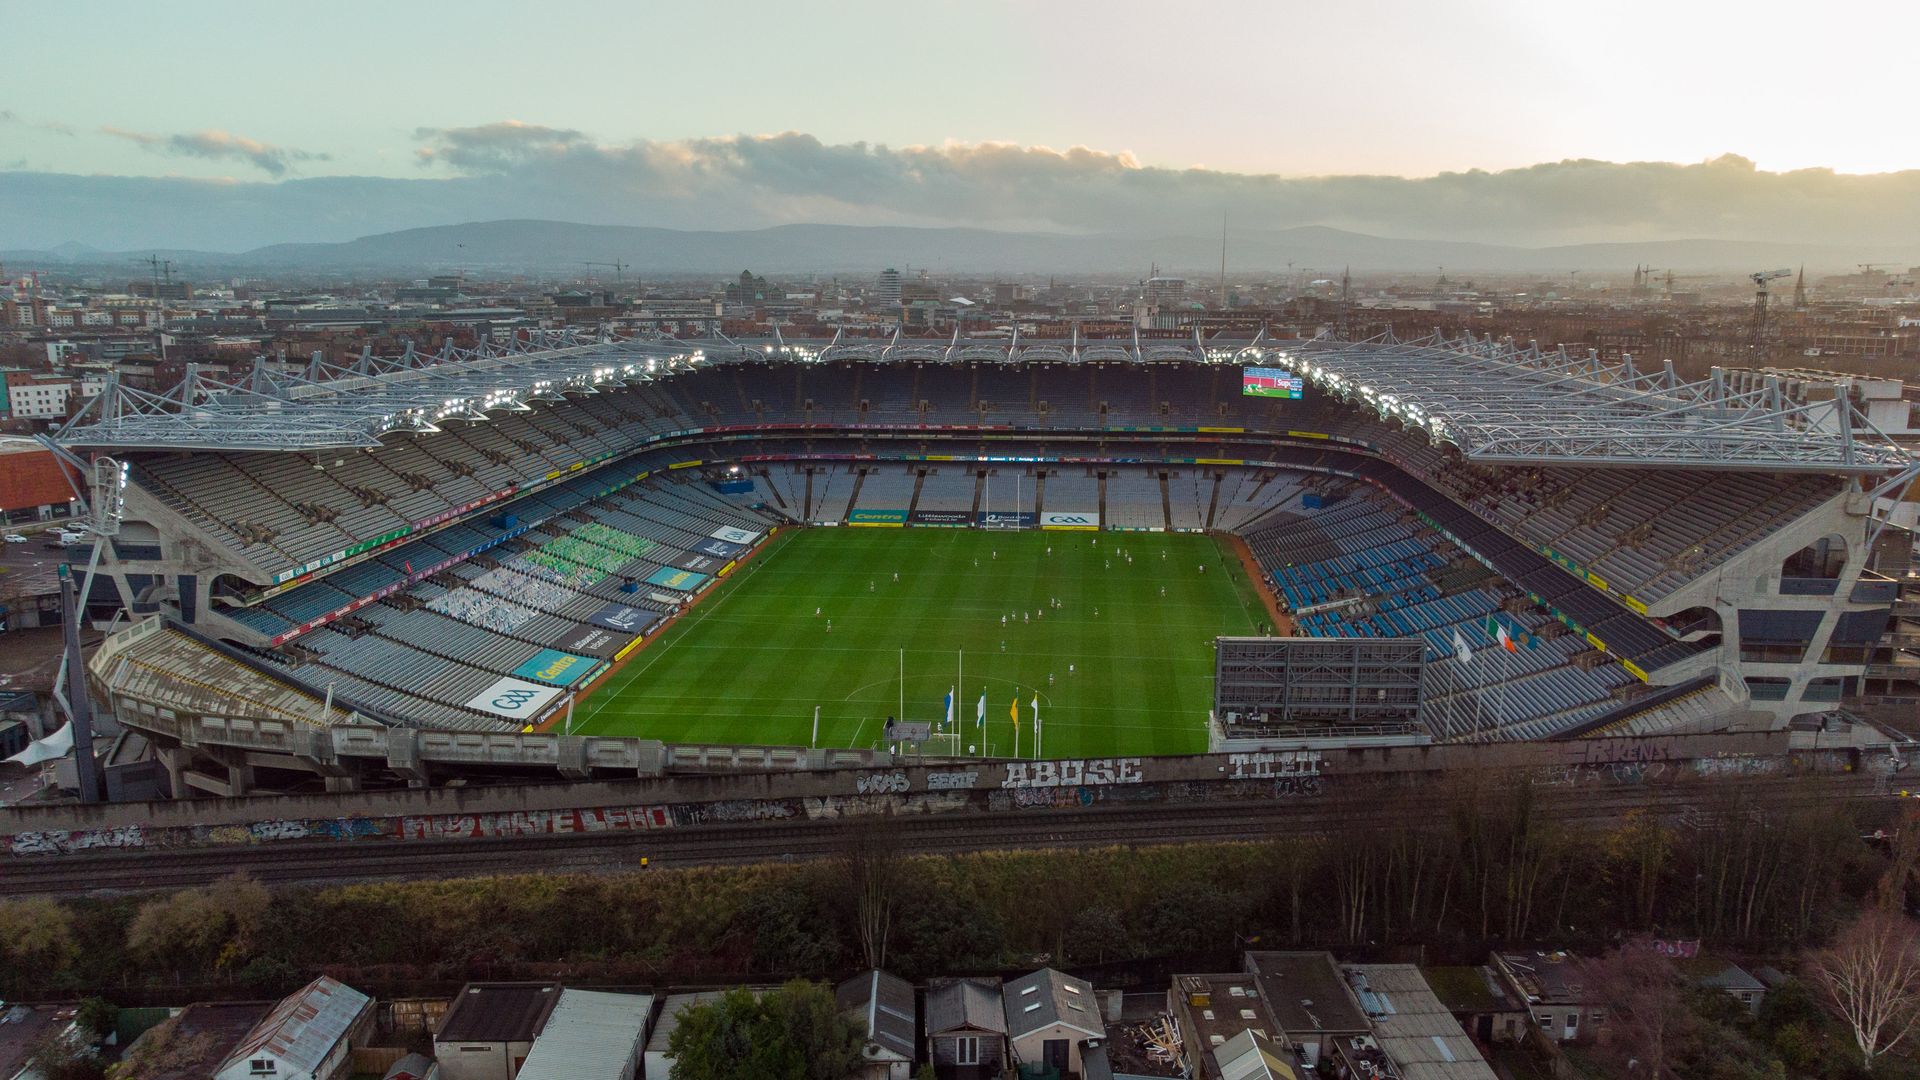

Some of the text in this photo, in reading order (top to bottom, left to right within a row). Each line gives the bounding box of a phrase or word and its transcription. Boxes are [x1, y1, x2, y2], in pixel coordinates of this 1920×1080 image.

[536, 655, 577, 680] Centra
[492, 689, 531, 710] GAA
[1001, 758, 1143, 789] ABUSE
[580, 804, 675, 833] LEGO
